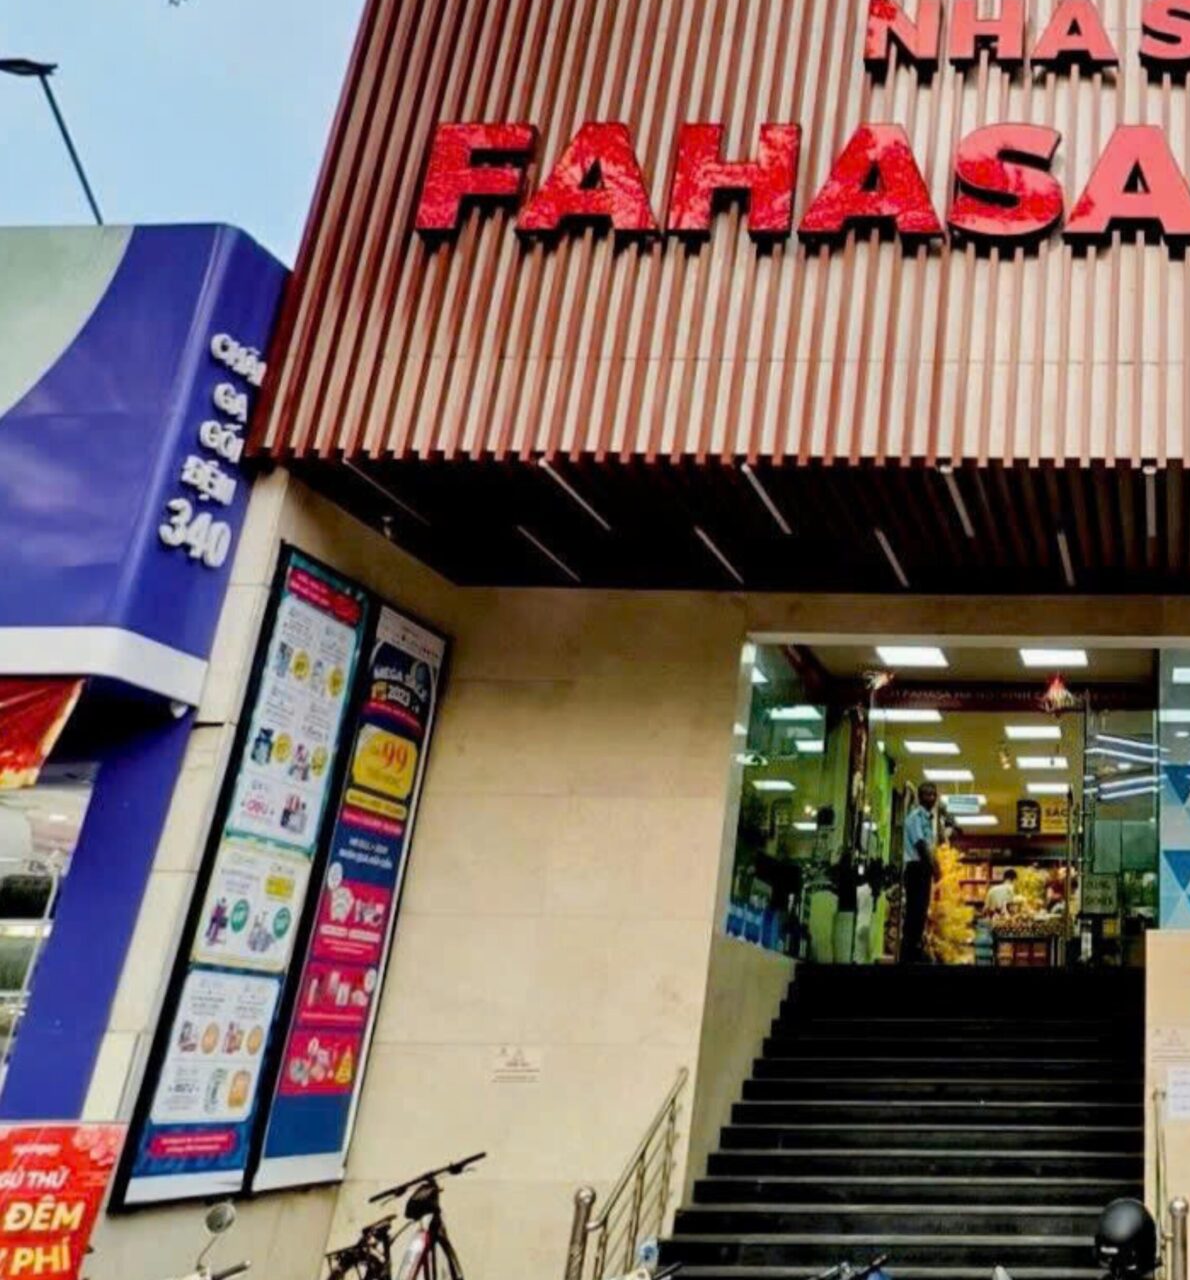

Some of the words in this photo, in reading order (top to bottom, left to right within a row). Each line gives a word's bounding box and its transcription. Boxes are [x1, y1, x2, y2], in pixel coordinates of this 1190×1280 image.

[159, 497, 232, 568] 340
[3, 1194, 86, 1232] ĐÊM
[10, 1235, 72, 1276] PHÍ
